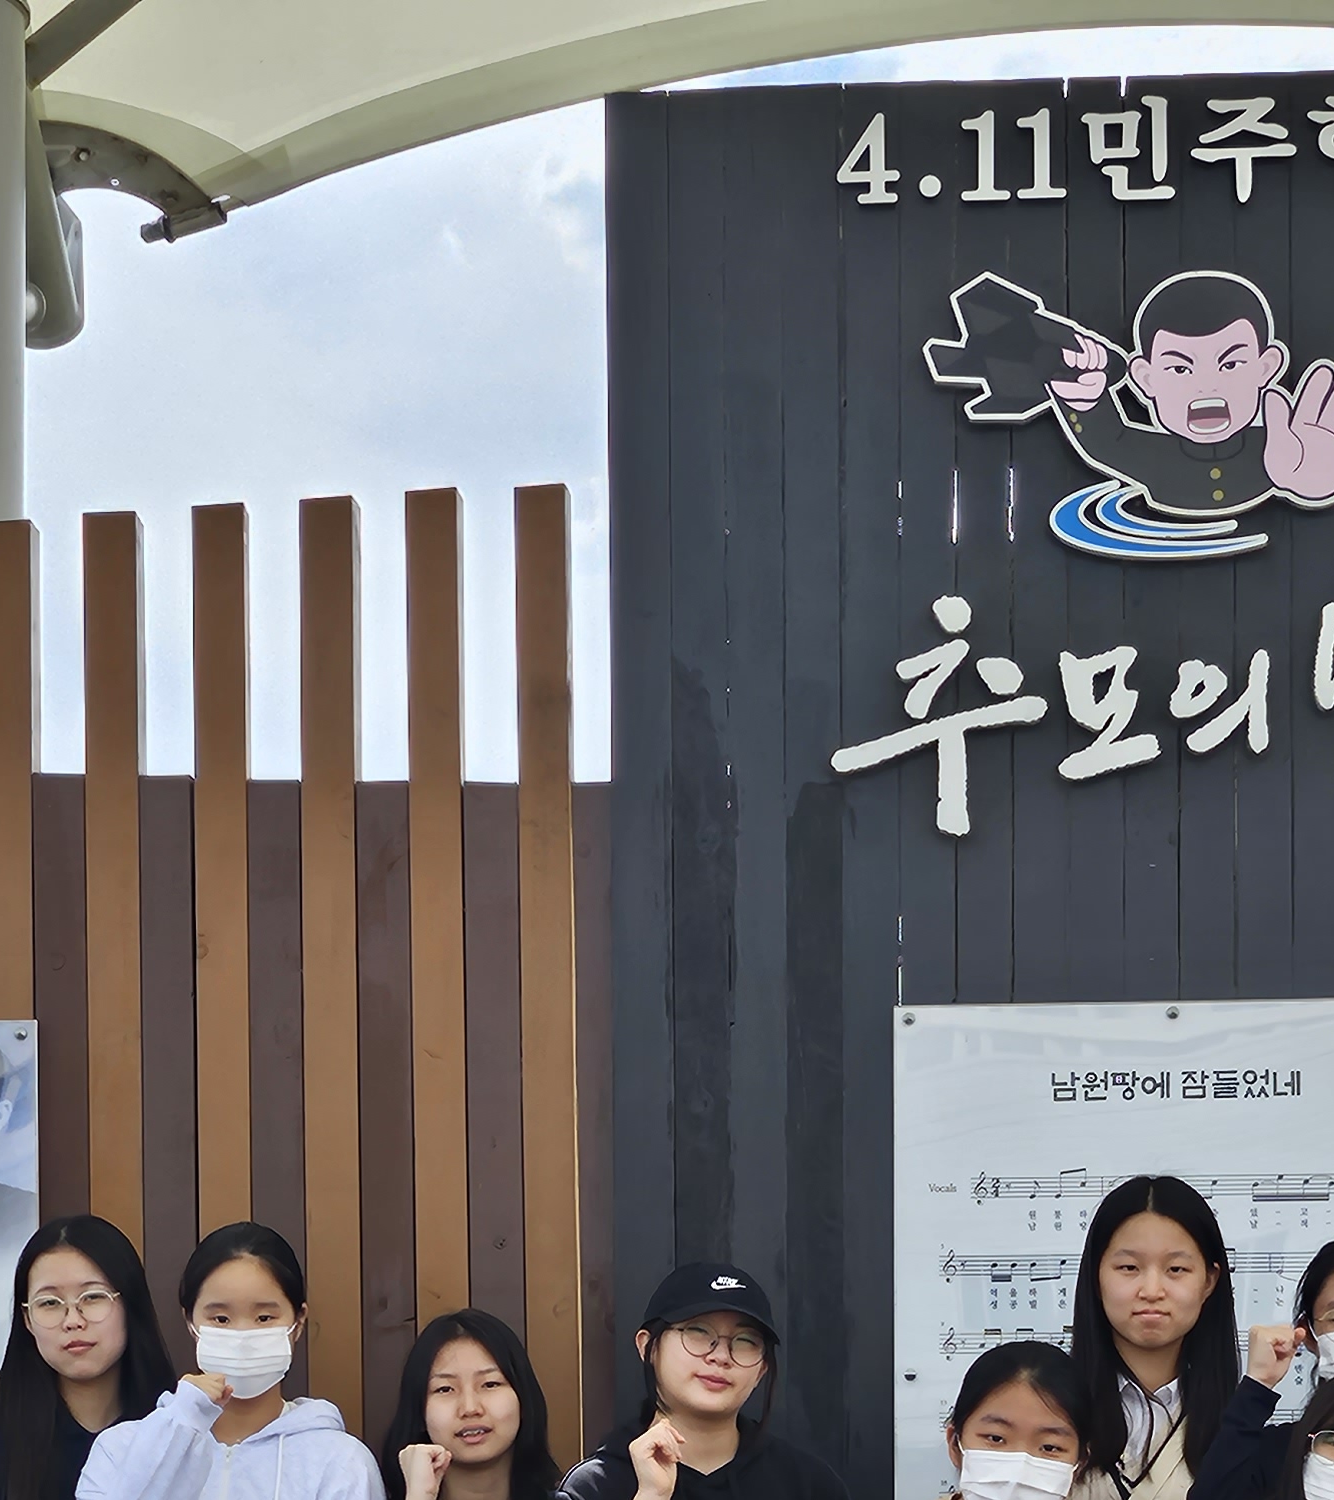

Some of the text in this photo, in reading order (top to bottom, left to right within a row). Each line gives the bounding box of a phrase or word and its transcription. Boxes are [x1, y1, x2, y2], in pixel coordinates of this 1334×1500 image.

[831, 595, 1272, 838] 추모의
[1050, 1069, 1302, 1102] 남원땅에 잠들었네
[929, 1183, 957, 1192] Vocals
